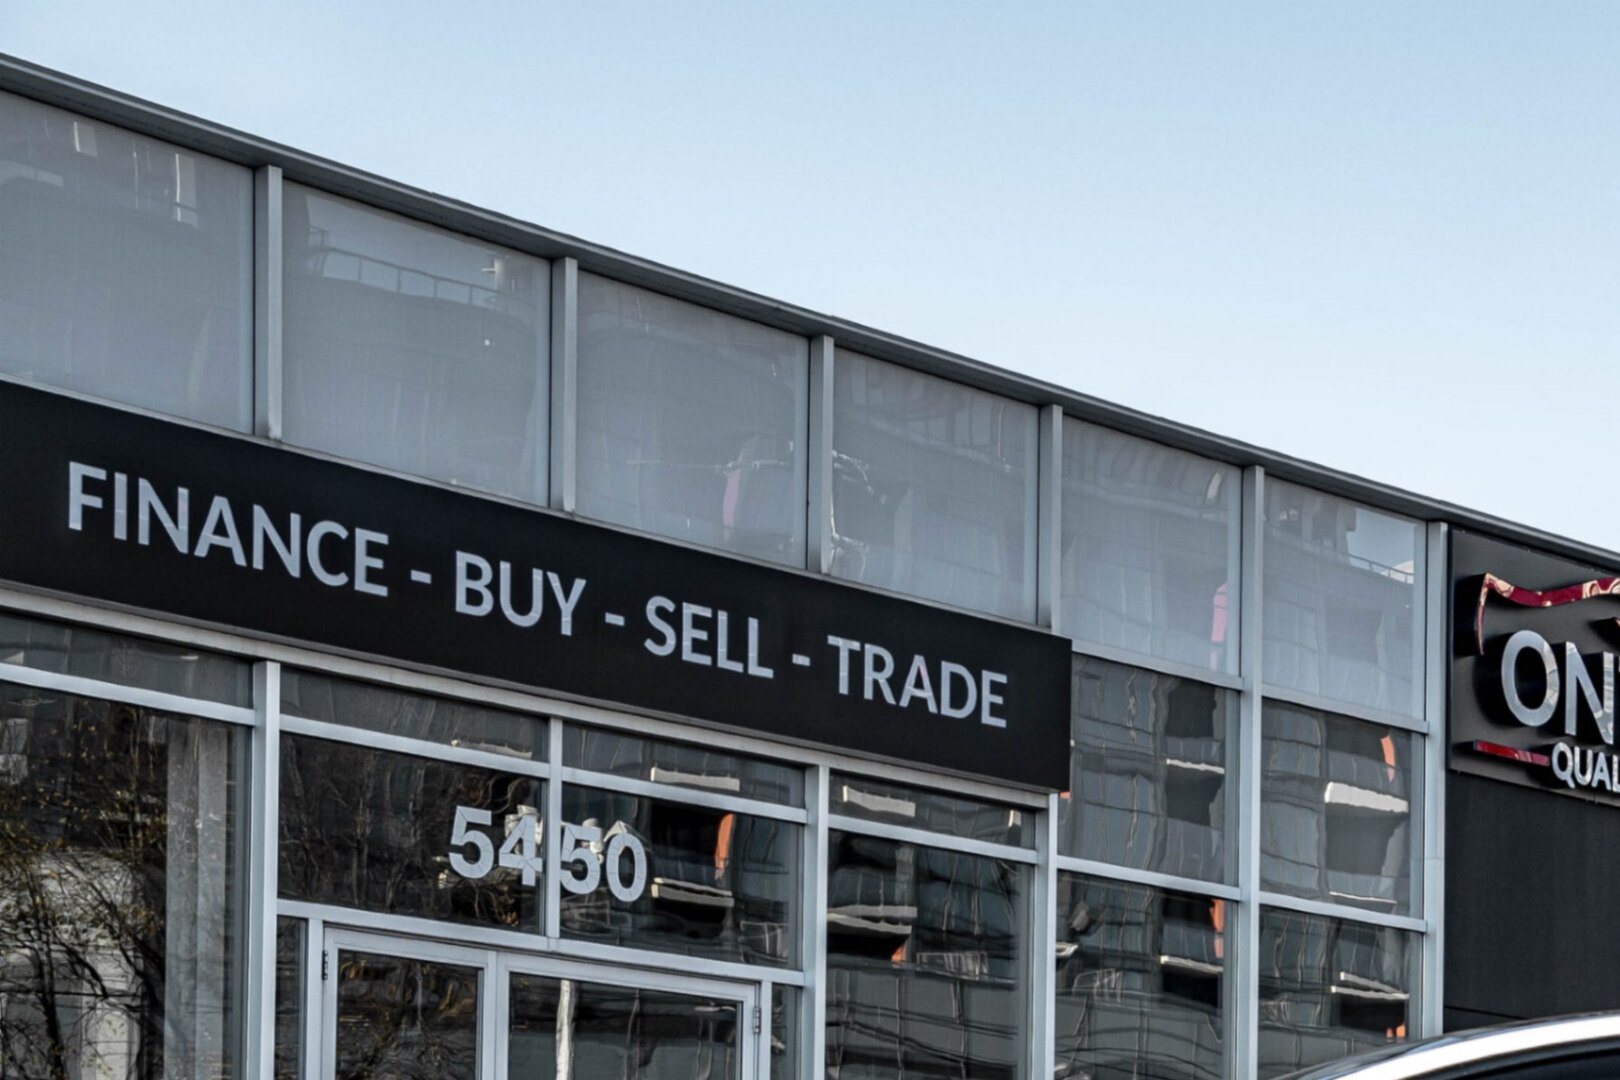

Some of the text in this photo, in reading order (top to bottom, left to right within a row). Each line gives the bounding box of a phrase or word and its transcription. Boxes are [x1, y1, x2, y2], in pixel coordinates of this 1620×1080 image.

[68, 461, 389, 597] FINANCE
[455, 550, 587, 636] BUY
[643, 595, 774, 679] SELL
[827, 634, 1008, 728] TRADE
[449, 805, 647, 902] 5450
